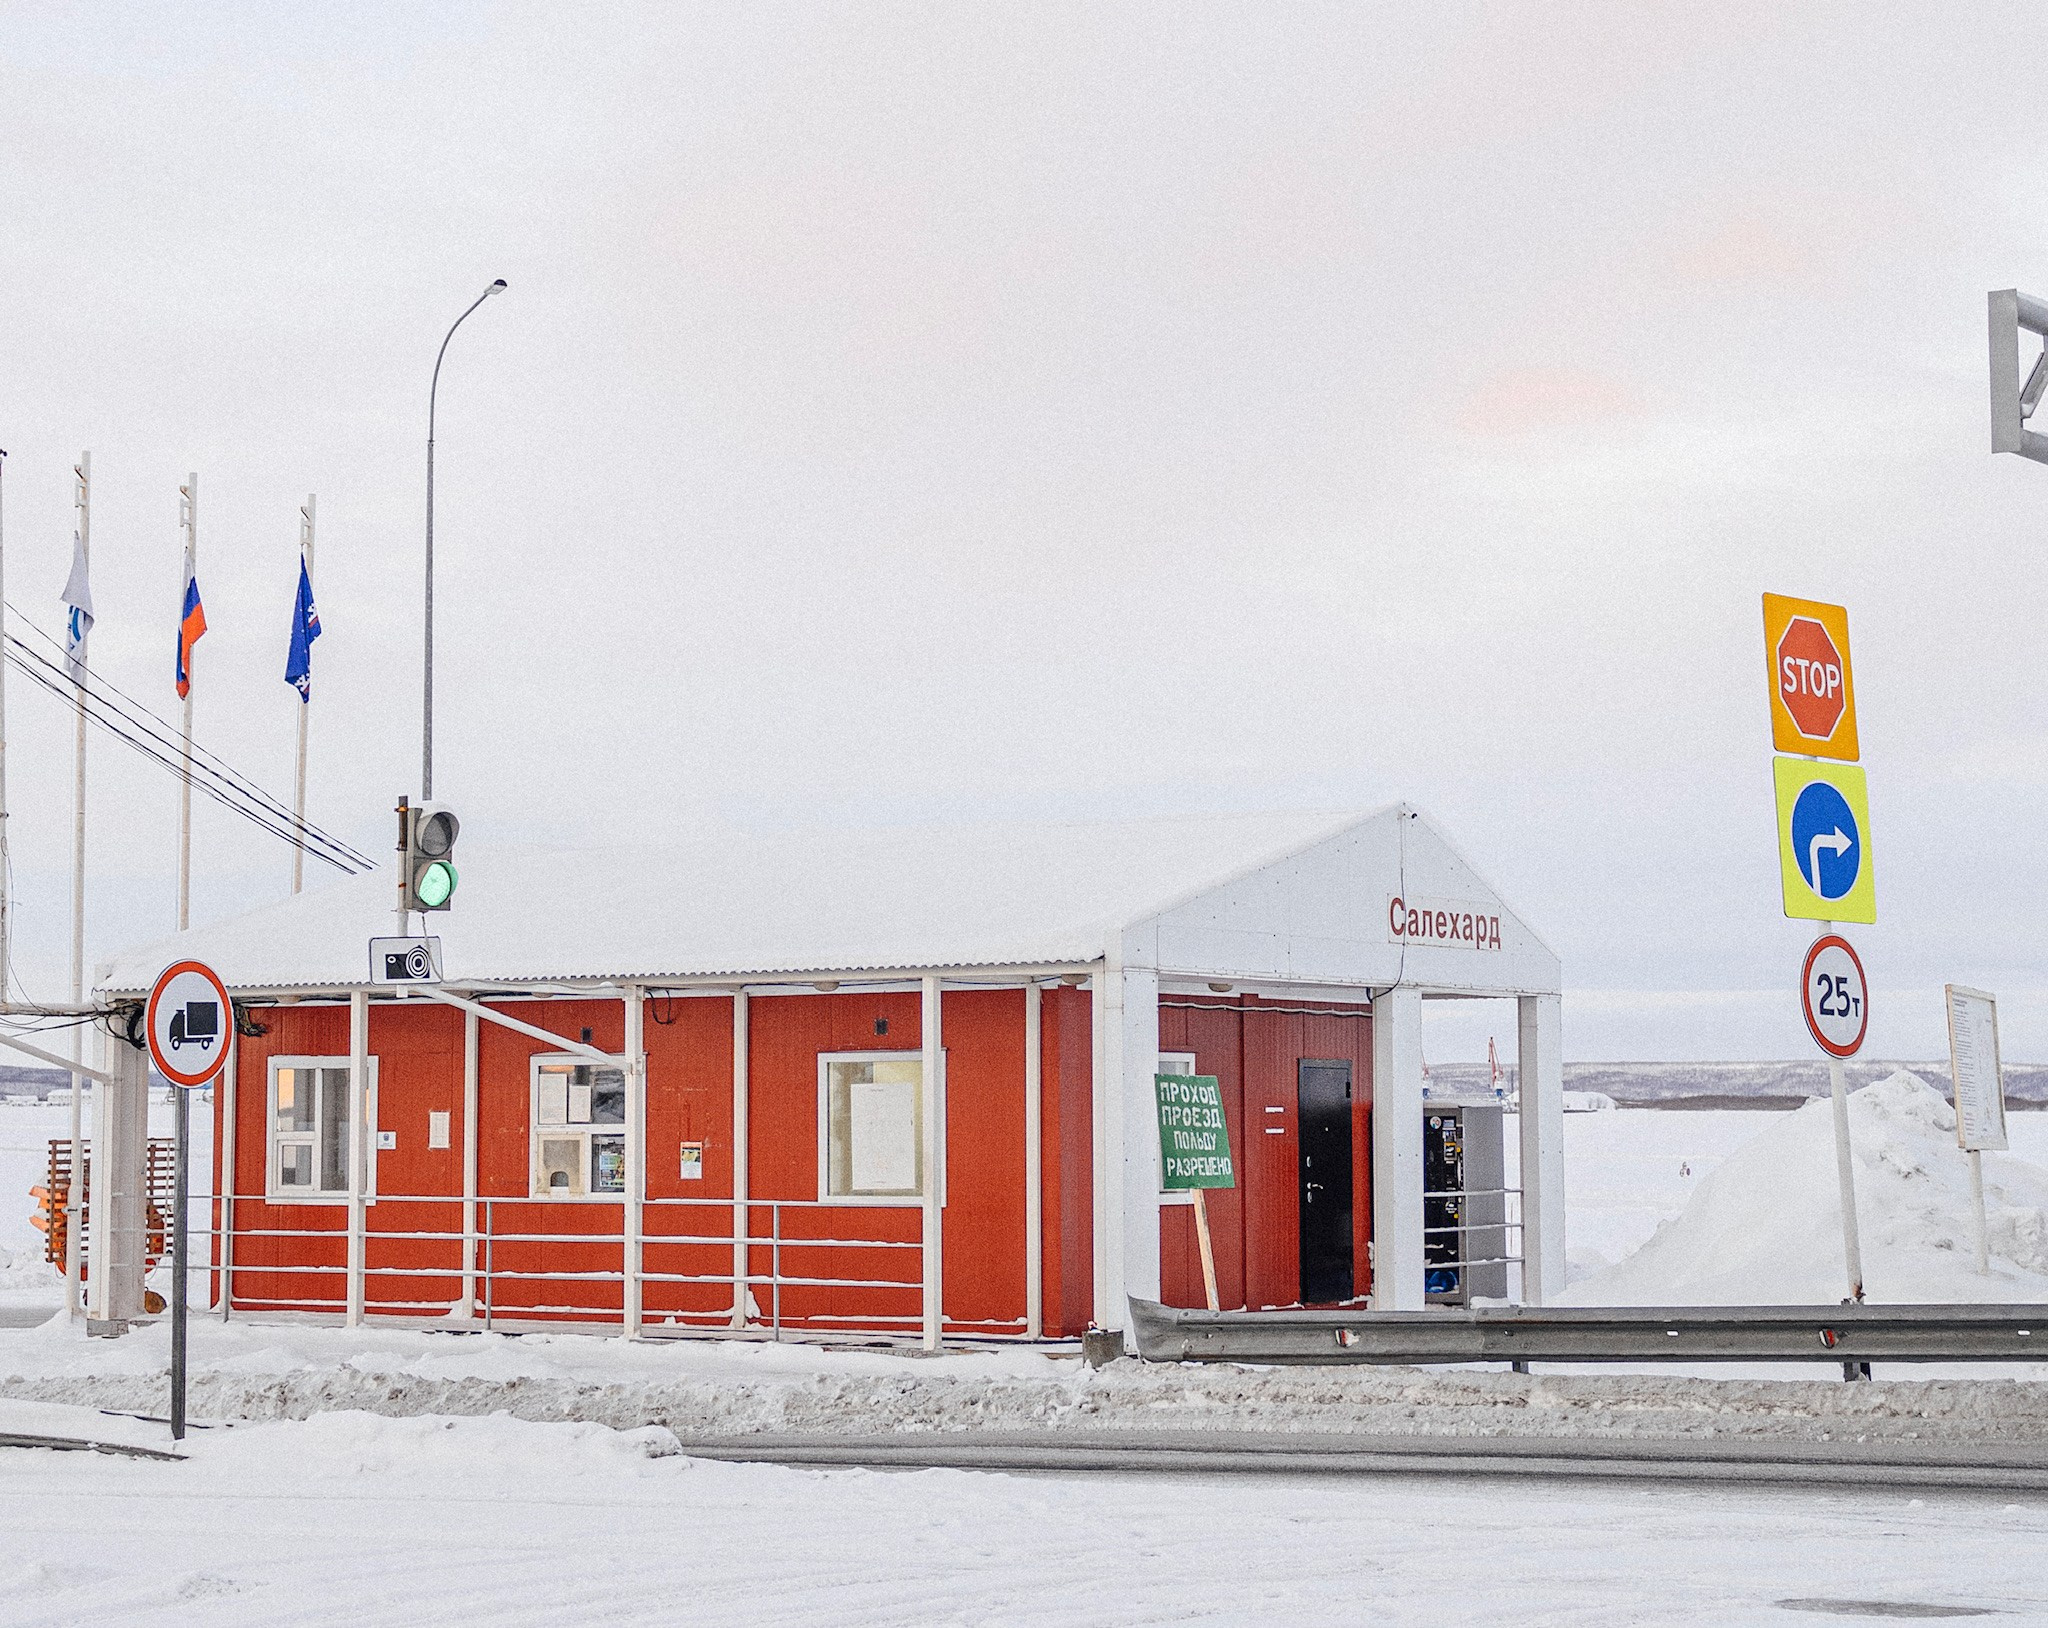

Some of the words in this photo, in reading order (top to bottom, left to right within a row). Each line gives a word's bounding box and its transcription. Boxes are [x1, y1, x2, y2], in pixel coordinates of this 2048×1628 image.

[1783, 655, 1840, 699] STOP
[1390, 897, 1501, 950] Салехард
[1160, 1082, 1218, 1106] ПРОХОД
[1161, 1105, 1222, 1129] ПРОЕЗД
